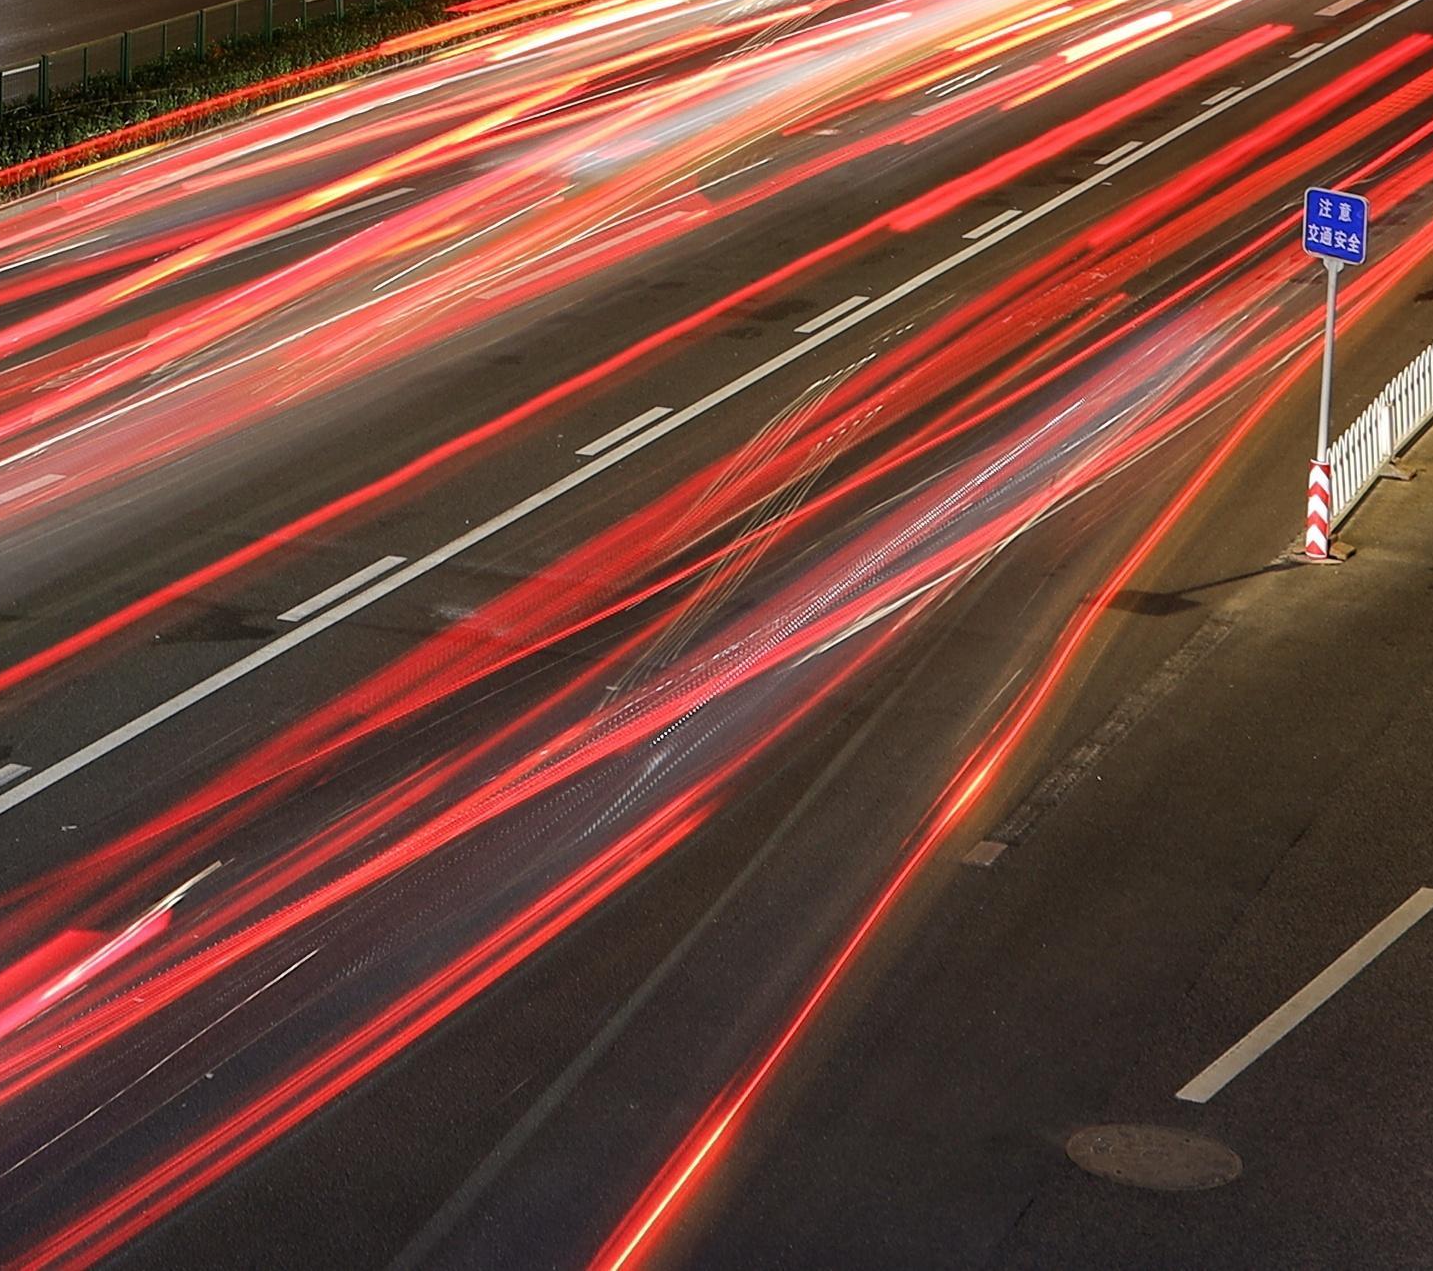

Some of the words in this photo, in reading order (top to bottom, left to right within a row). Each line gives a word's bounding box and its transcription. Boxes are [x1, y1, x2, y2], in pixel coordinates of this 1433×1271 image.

[1317, 197, 1353, 223] 注意
[1307, 223, 1362, 254] 交通安全
